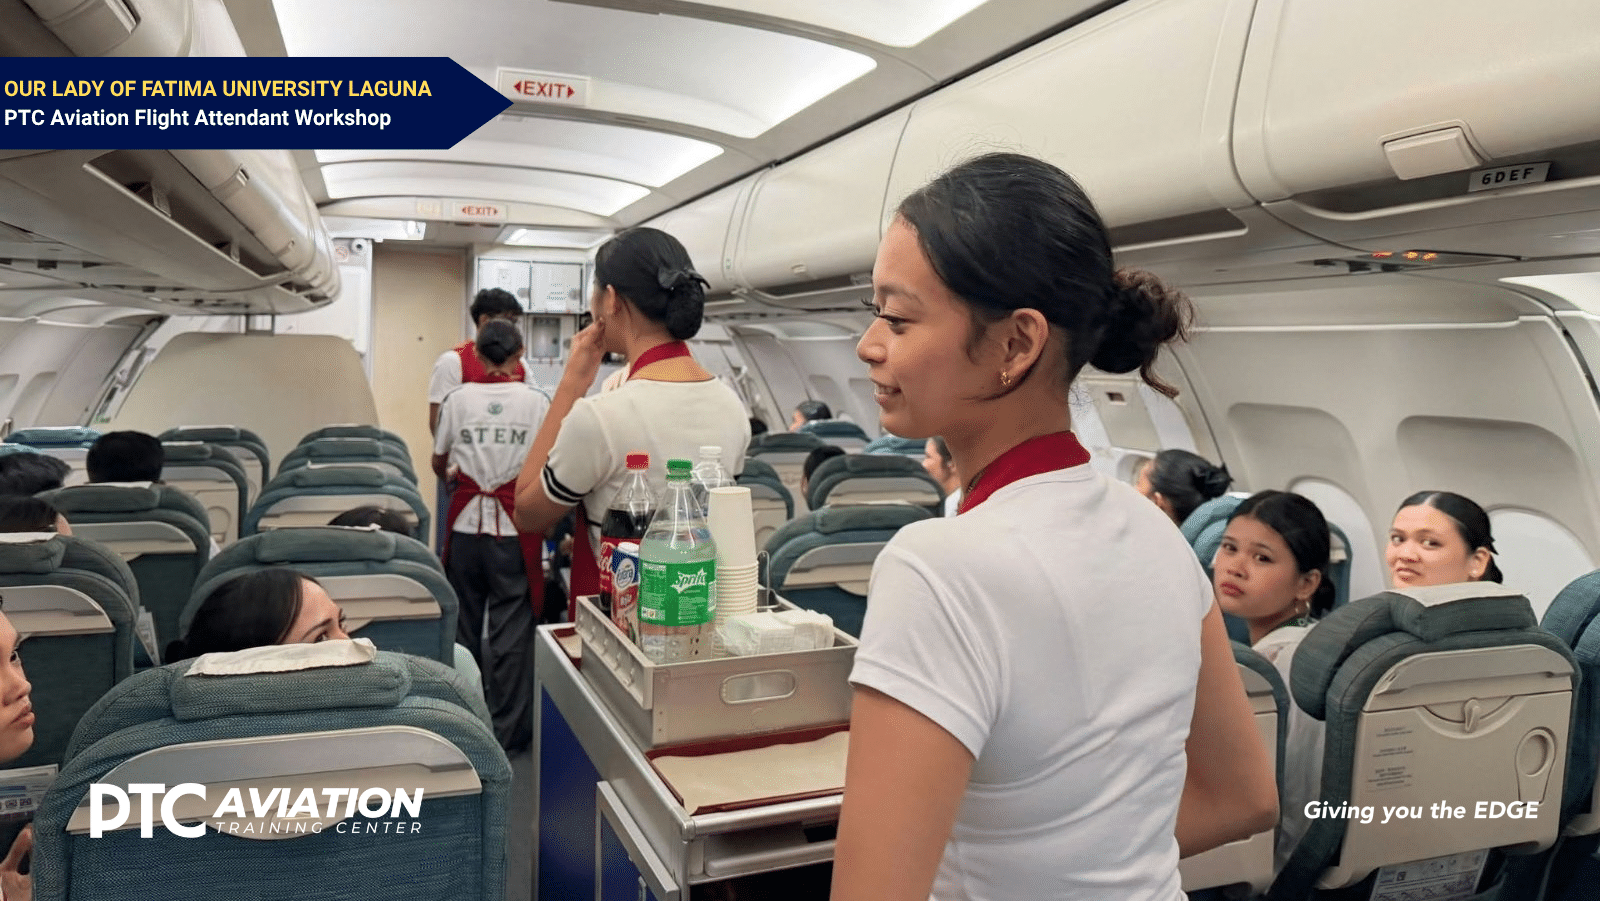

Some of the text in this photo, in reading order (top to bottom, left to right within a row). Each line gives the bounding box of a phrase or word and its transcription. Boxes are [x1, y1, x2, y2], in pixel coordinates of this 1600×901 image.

[523, 80, 566, 98] EXIT
[1481, 166, 1535, 186] 6DEF
[466, 206, 493, 216] EXIT
[460, 427, 528, 445] STEM
